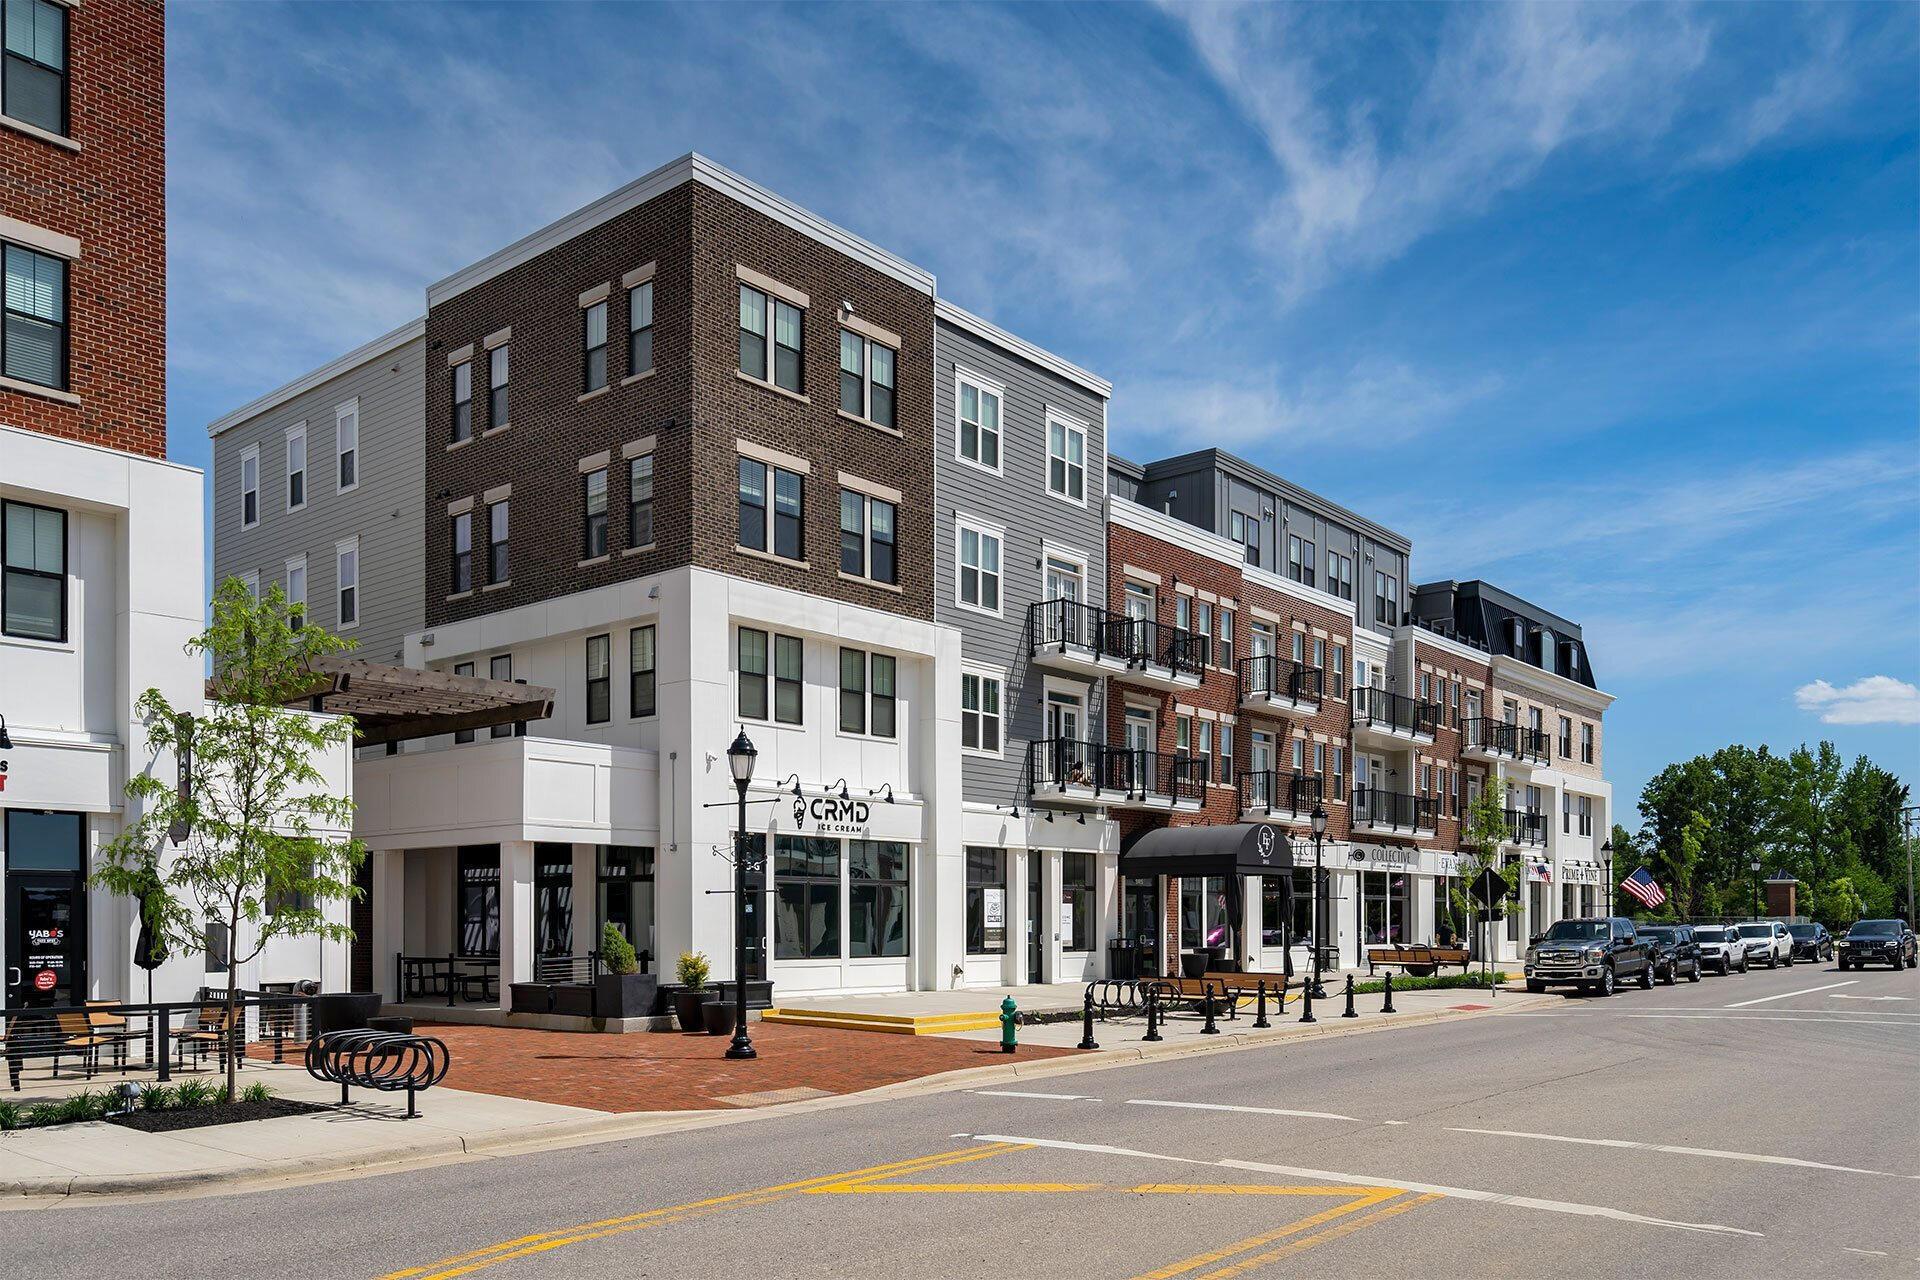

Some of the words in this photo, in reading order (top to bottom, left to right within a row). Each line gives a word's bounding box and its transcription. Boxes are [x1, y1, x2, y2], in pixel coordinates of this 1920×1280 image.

[810, 798, 869, 823] CRMD
[818, 823, 831, 831] ICE
[835, 824, 862, 833] CREAM
[1371, 848, 1411, 864] COLLECTIVE
